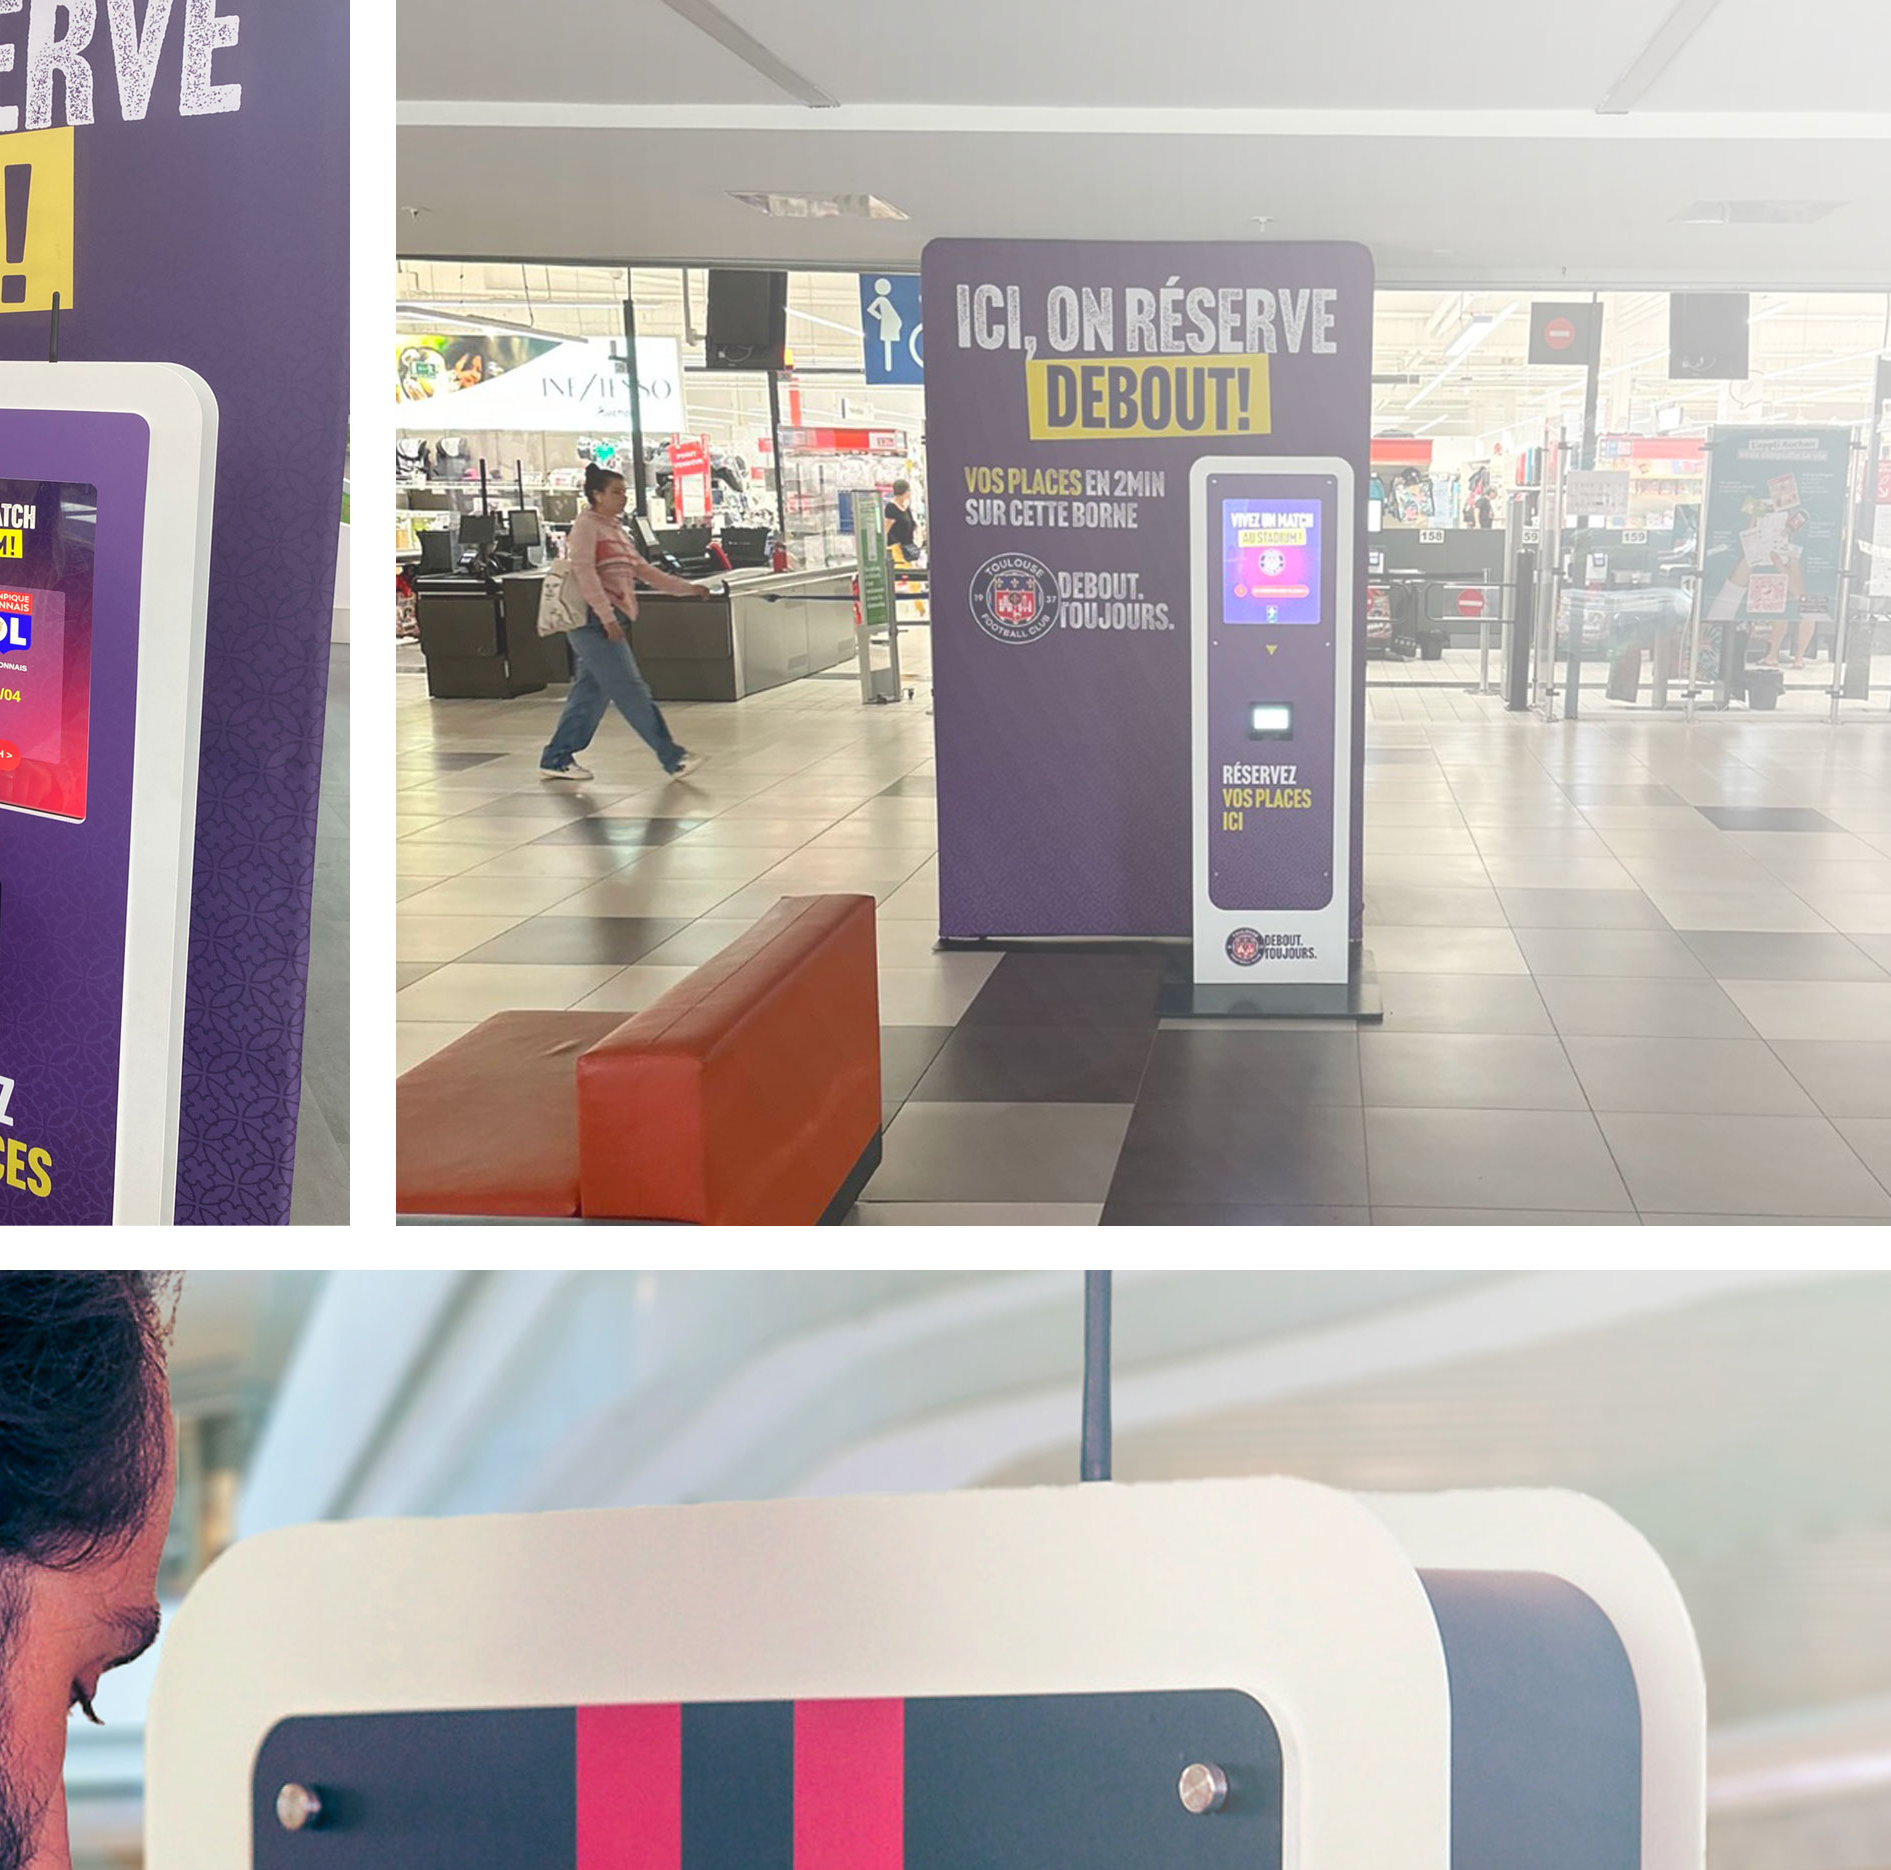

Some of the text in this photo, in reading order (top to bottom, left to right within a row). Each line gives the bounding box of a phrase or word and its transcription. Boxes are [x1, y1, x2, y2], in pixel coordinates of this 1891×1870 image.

[956, 276, 1337, 361] ICI, ON RÉSERVE
[1046, 365, 1251, 431] DEBOUT!
[964, 467, 1165, 497] VOS PLACES EN 2MIN
[965, 499, 1138, 529] SUR CETTE BORNE
[1421, 532, 1444, 542] 158
[1624, 532, 1646, 542] 159
[985, 557, 1045, 578] TOULOUSE
[1059, 572, 1144, 600] DEBOUT.
[1060, 602, 1175, 630] TOUJOURS.
[1223, 762, 1297, 785] RÉSERVEZ
[1223, 788, 1312, 809] VOS PLACES
[1223, 811, 1243, 831] ICI
